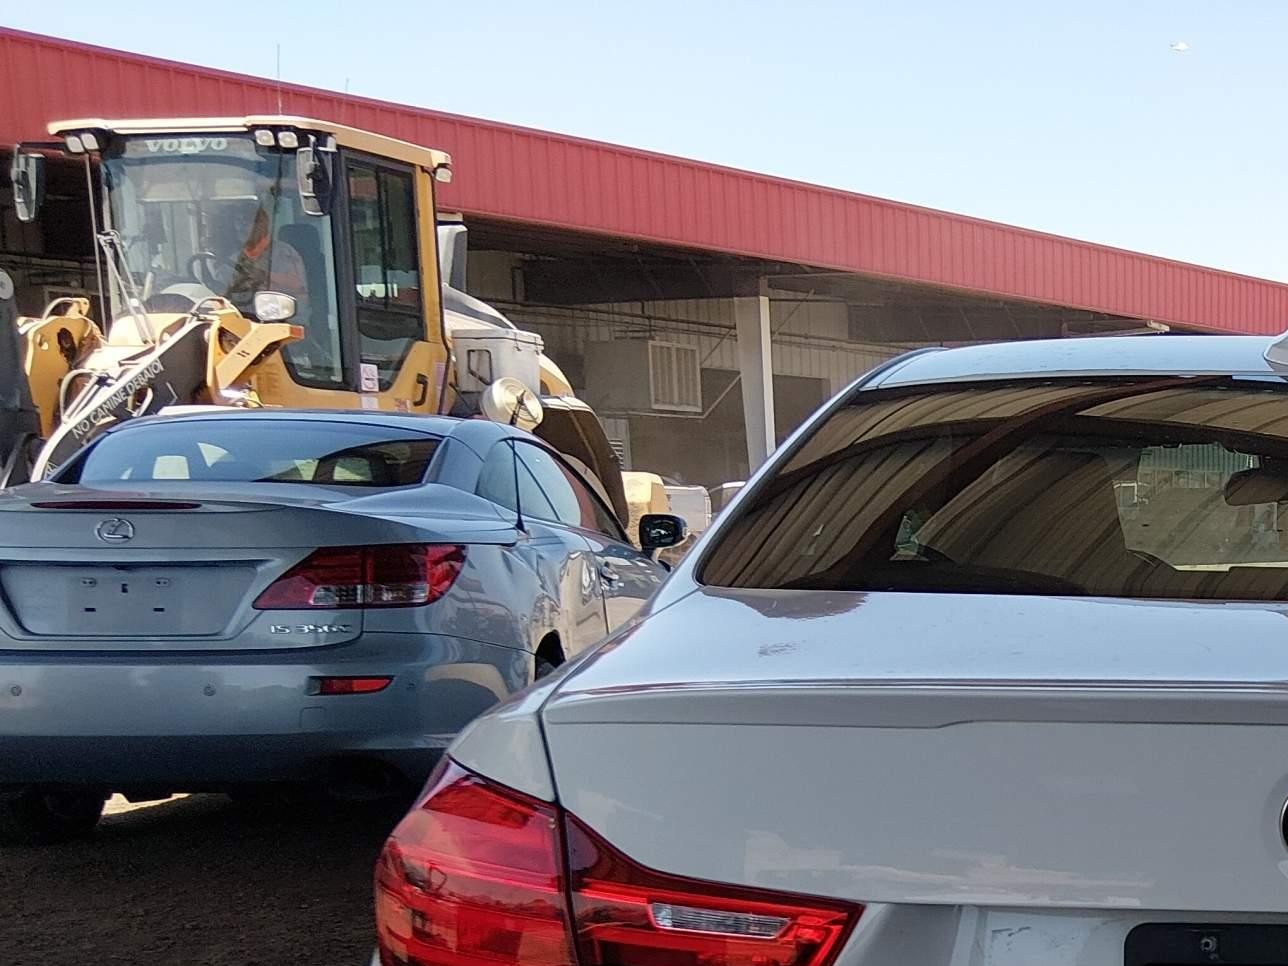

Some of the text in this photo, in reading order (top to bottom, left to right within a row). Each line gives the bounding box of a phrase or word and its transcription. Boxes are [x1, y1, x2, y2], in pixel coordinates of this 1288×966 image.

[144, 138, 227, 153] VOLVO
[71, 419, 90, 439] NO
[91, 390, 129, 423] CAMINE
[270, 624, 291, 635] IS
